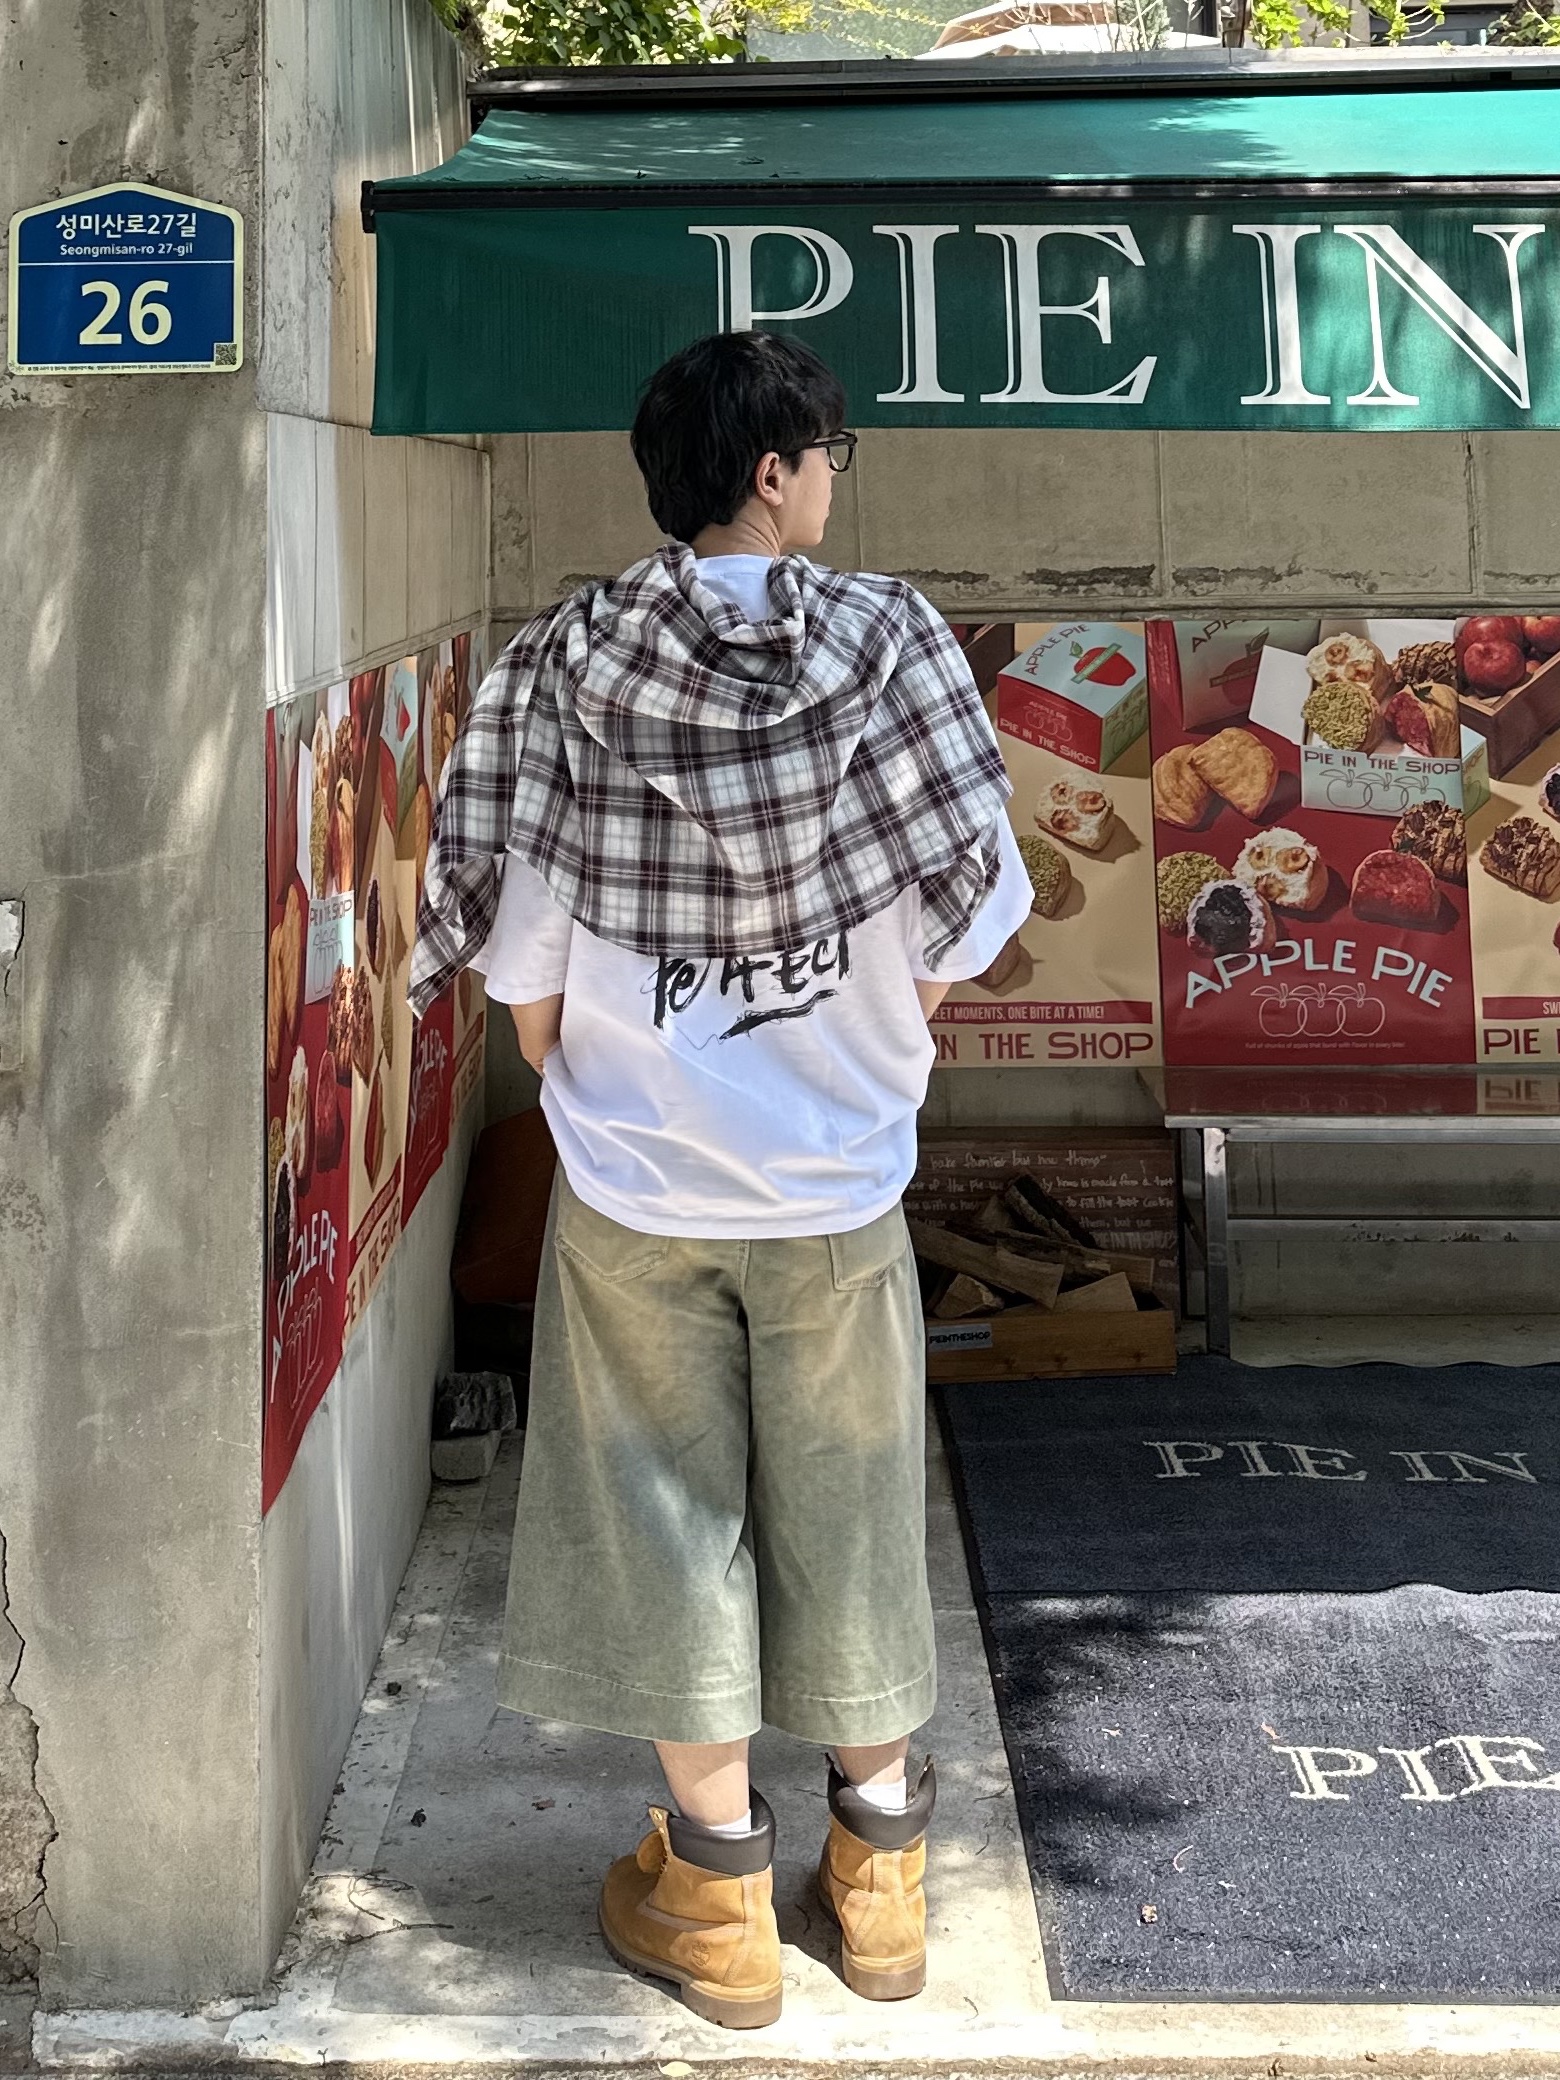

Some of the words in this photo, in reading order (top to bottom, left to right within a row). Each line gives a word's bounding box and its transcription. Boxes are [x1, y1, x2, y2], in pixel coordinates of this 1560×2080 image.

[56, 213, 197, 240] 성미산로27길
[60, 244, 155, 258] Seongmisan-ro
[158, 243, 193, 257] 27-gil
[79, 280, 173, 345] 26
[688, 225, 1157, 404] PIE
[1232, 223, 1546, 410] IN
[1024, 637, 1061, 676] APPLE
[1060, 623, 1090, 639] PIE
[1000, 717, 1019, 733] PIE
[1022, 728, 1032, 740] IN
[1038, 734, 1057, 751] THE
[1060, 744, 1096, 765] SHOP
[1304, 749, 1334, 765] PIE
[1342, 755, 1357, 768] IN
[1367, 756, 1399, 772] THE
[1405, 757, 1461, 775] SHOP
[1185, 938, 1357, 1008] APPLE
[1371, 946, 1453, 1008] PIE
[1008, 1006, 1029, 1020] ONE
[1030, 1006, 1051, 1020] BITE
[1054, 1006, 1065, 1019] AT
[1068, 1006, 1076, 1019] A
[1077, 1005, 1105, 1019] TIME!
[979, 1033, 1035, 1059] THE
[1048, 1032, 1154, 1060] SHOP
[1484, 1029, 1541, 1055] PIE
[1142, 1440, 1368, 1482] PIE
[1389, 1451, 1540, 1484] IN
[1271, 1735, 1560, 1802] PIE
